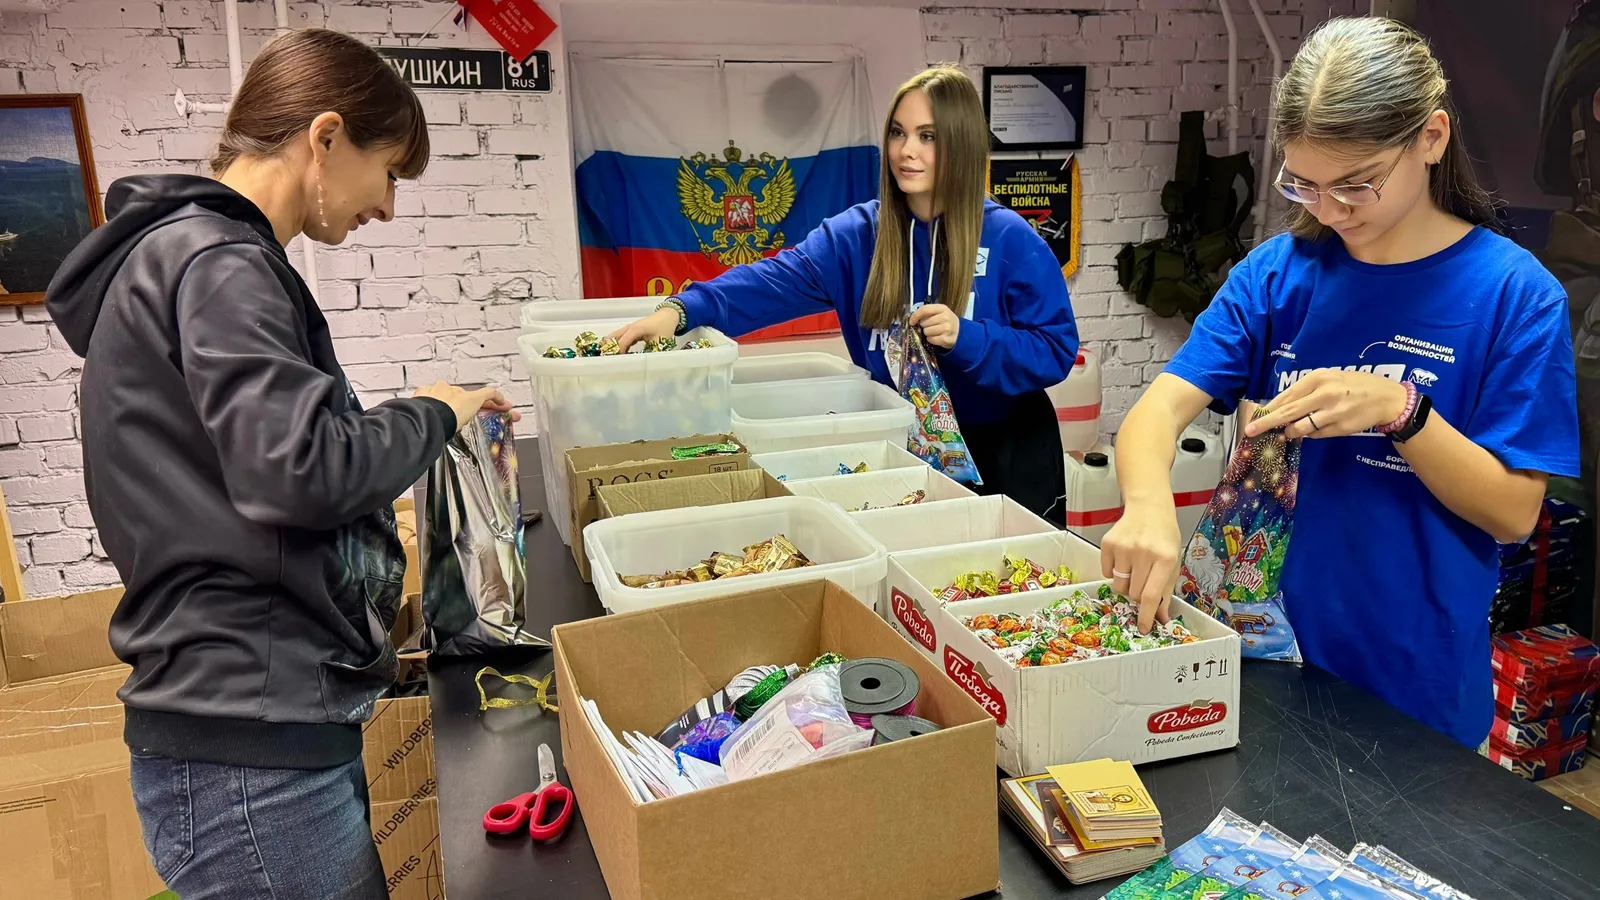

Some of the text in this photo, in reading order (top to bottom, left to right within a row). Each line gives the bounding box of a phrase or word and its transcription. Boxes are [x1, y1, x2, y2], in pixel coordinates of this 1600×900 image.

[386, 58, 482, 86] УШКИН
[507, 54, 539, 79] 81
[512, 78, 536, 88] RUS
[994, 183, 1068, 195] БЕСПИЛОТНЫЕ
[1011, 195, 1051, 207] ВОЙСКА
[1387, 341, 1456, 364] ВОЗМОЖНОСТЕЙ
[1394, 334, 1455, 355] ОРГАНИЗАЦИЯ
[894, 594, 934, 647] Pobeda
[948, 651, 1001, 715] Победа
[1154, 708, 1221, 730] Pobeda
[383, 714, 432, 771] WILDBER
[1144, 729, 1226, 747] Pobeda Confectionery
